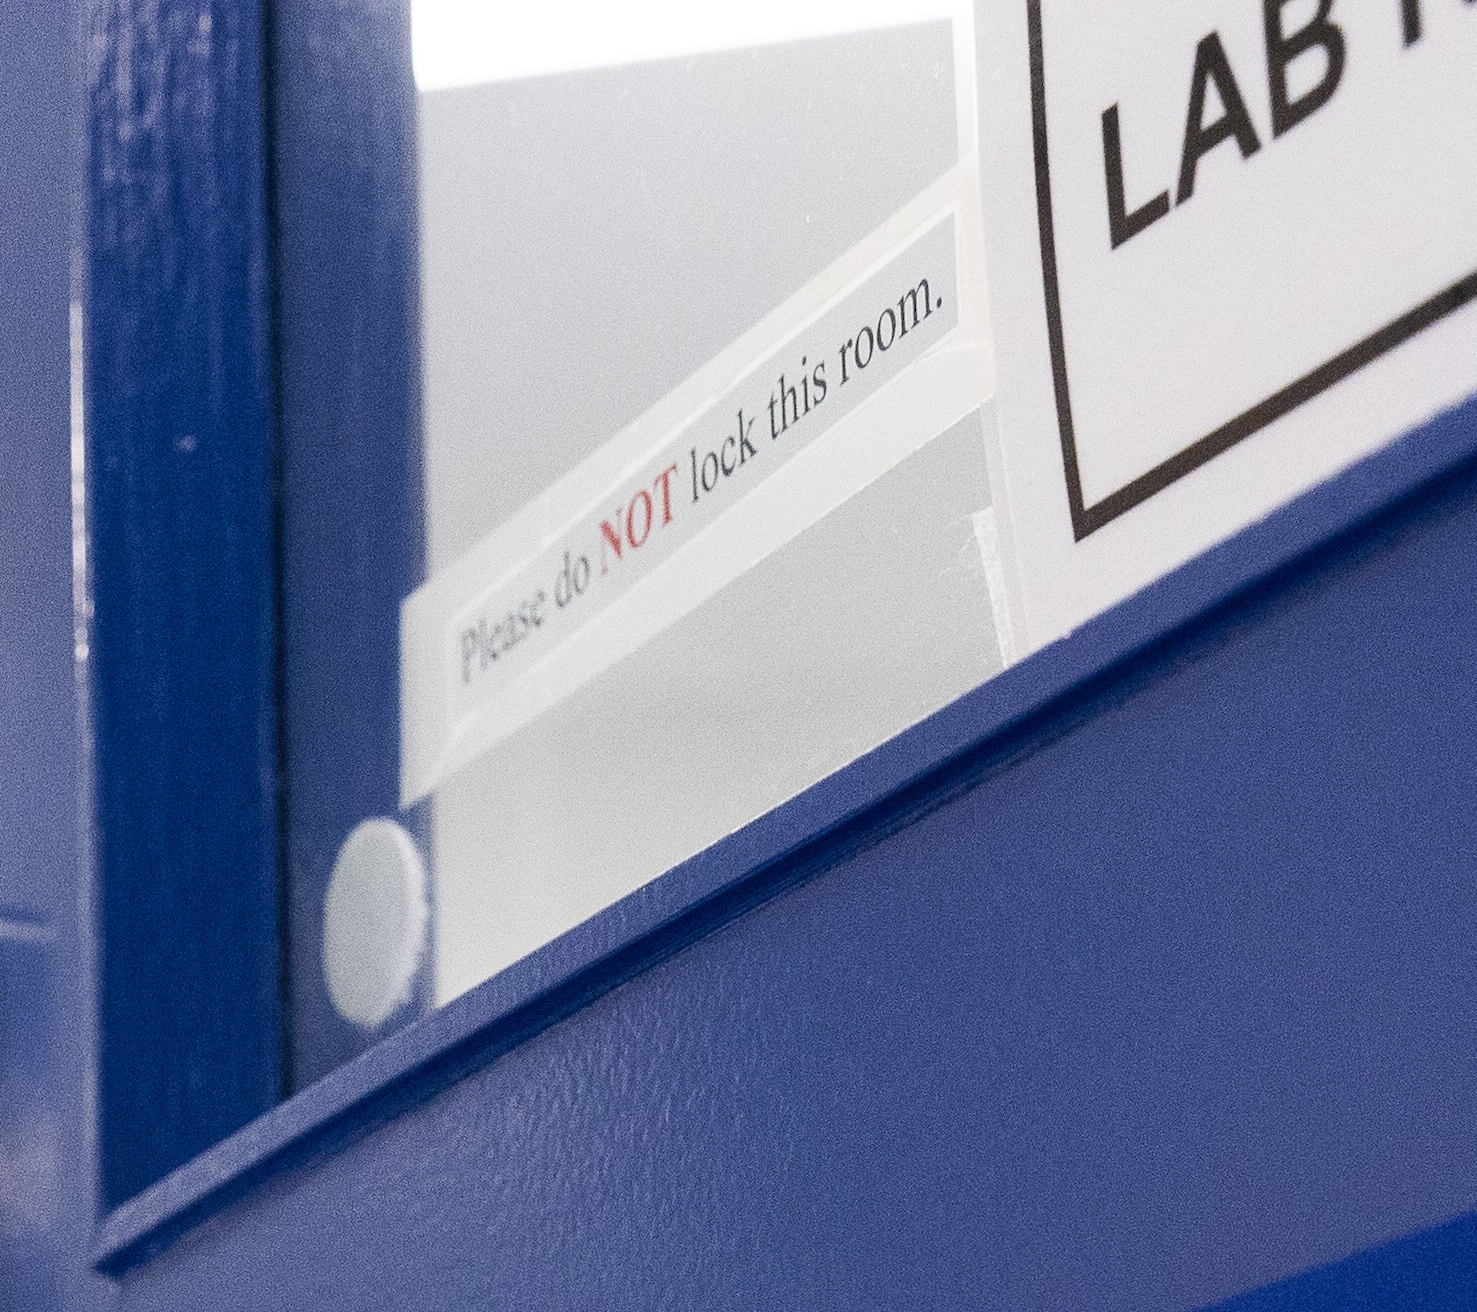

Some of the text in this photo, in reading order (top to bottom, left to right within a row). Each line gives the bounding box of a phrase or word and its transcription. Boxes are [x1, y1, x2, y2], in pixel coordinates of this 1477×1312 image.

[1100, 0, 1349, 250] LAB
[458, 276, 943, 685] Please do NOT lock this room.
